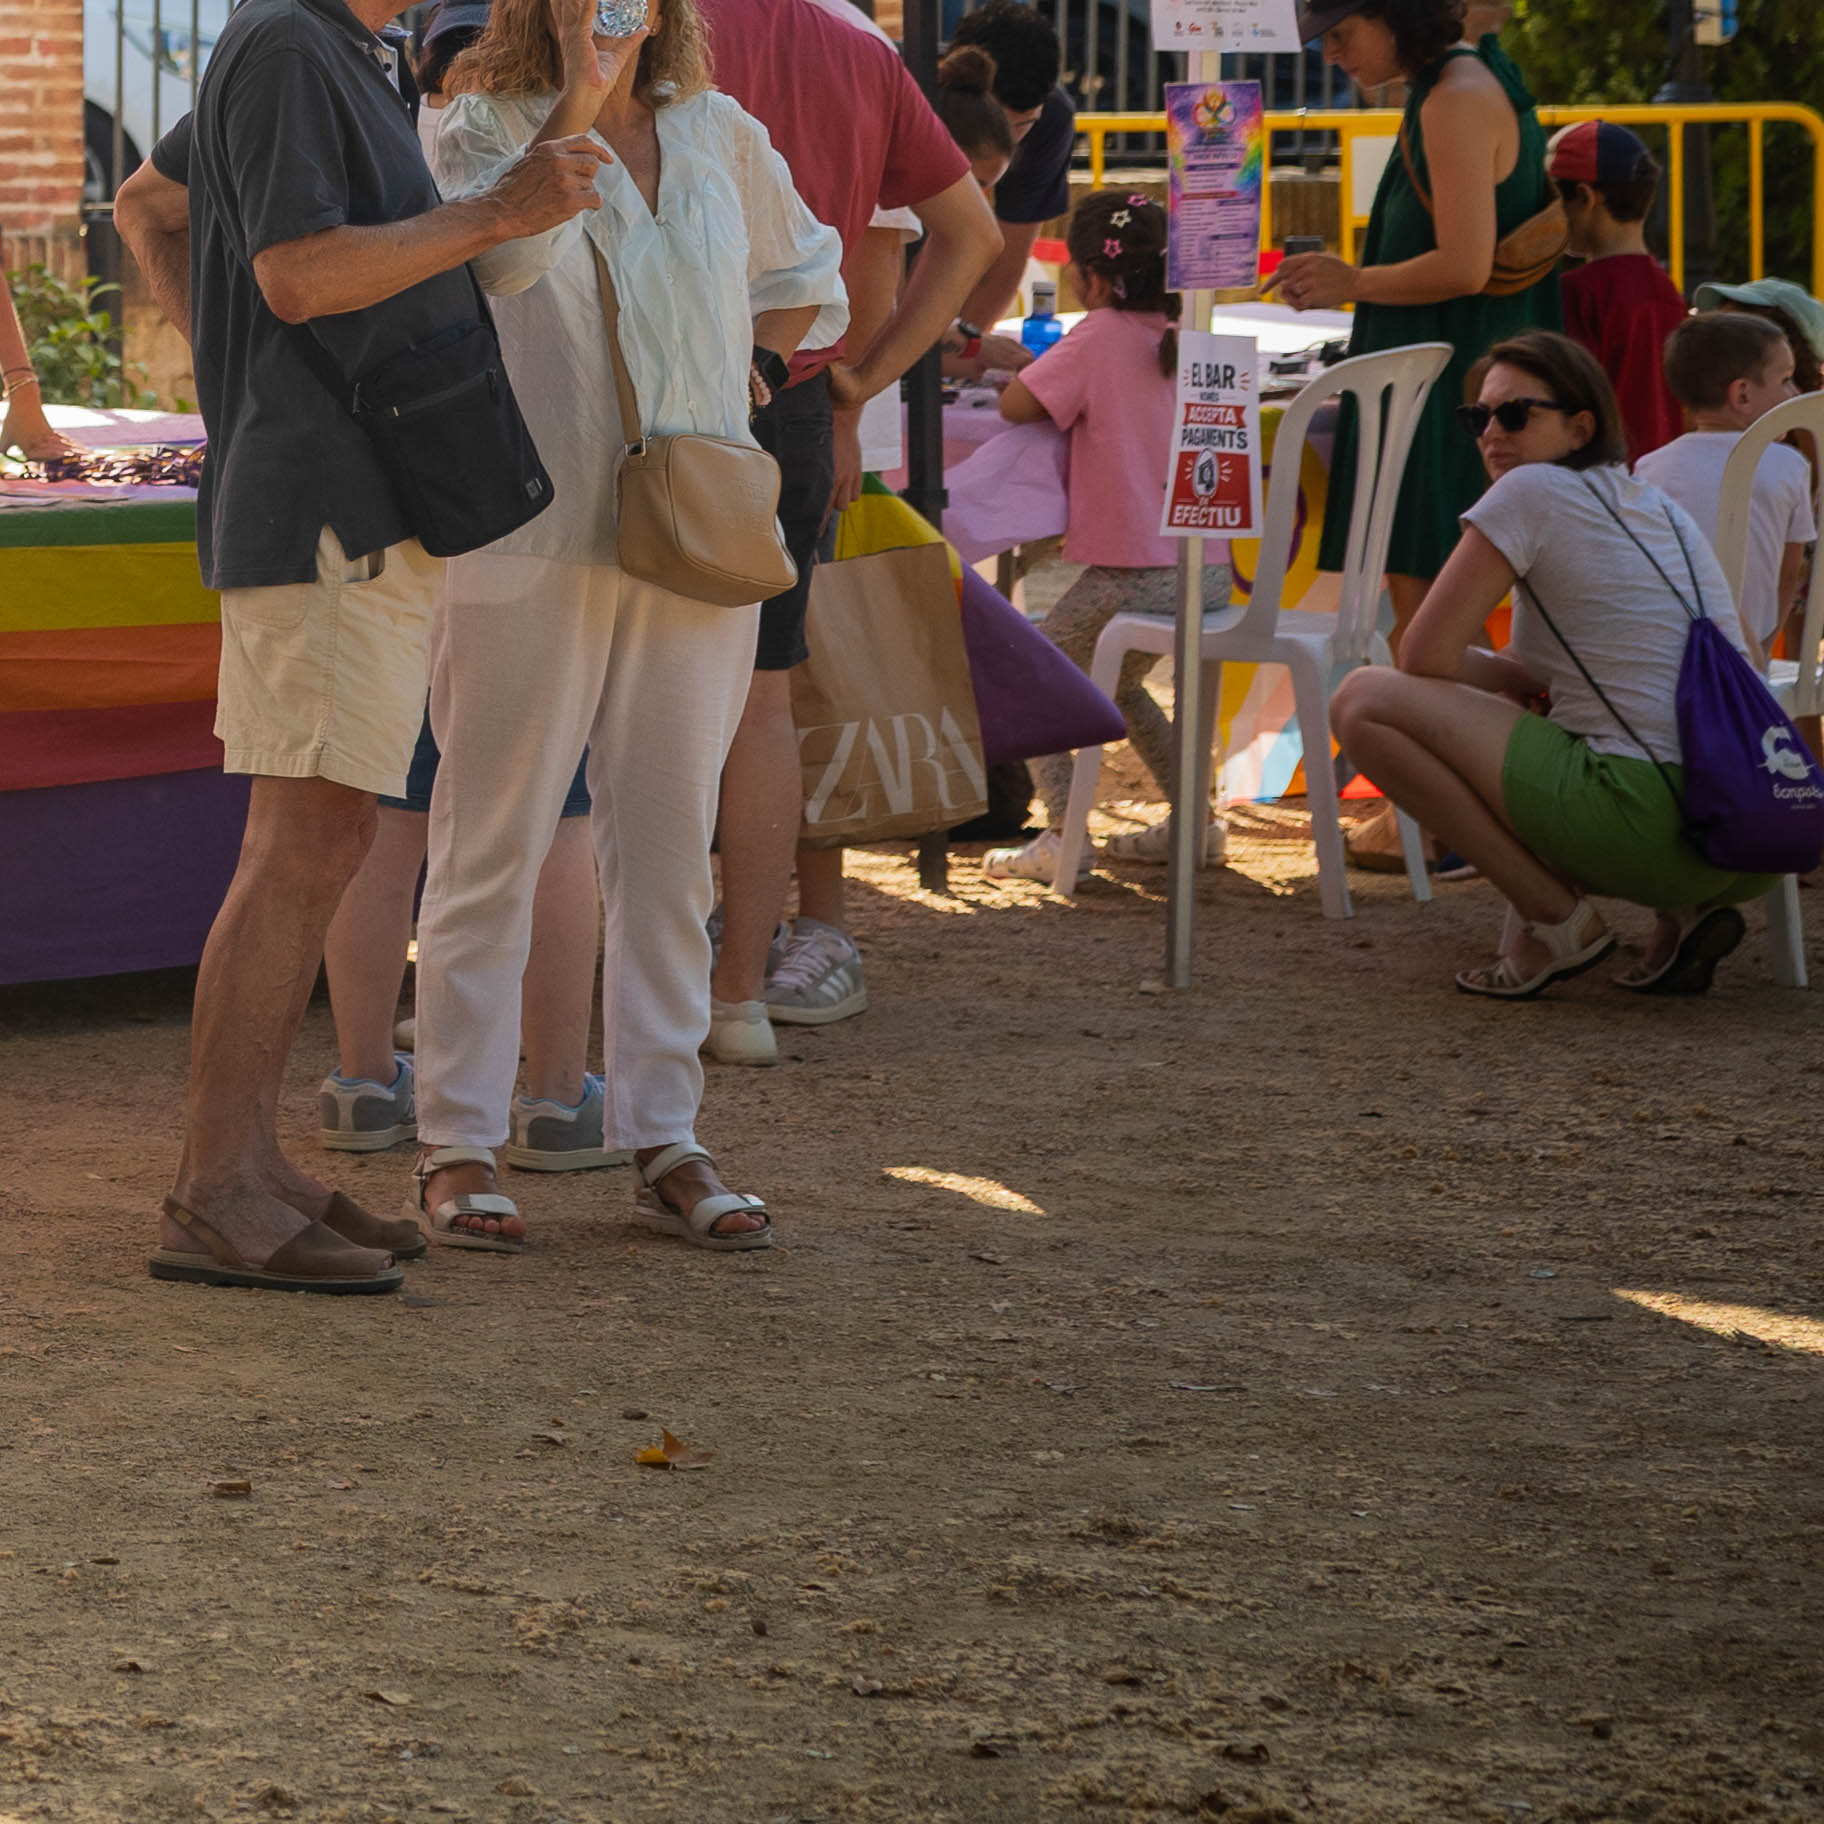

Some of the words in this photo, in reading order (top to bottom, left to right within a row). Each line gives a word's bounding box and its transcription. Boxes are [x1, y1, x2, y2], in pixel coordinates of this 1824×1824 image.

[1191, 362, 1205, 387] EL
[1205, 362, 1236, 389] BAR
[1188, 406, 1237, 425] ACCEPTA
[1180, 427, 1248, 450] PAGAMENTS
[1172, 504, 1242, 527] EFECTIU
[798, 705, 988, 824] ZARA
